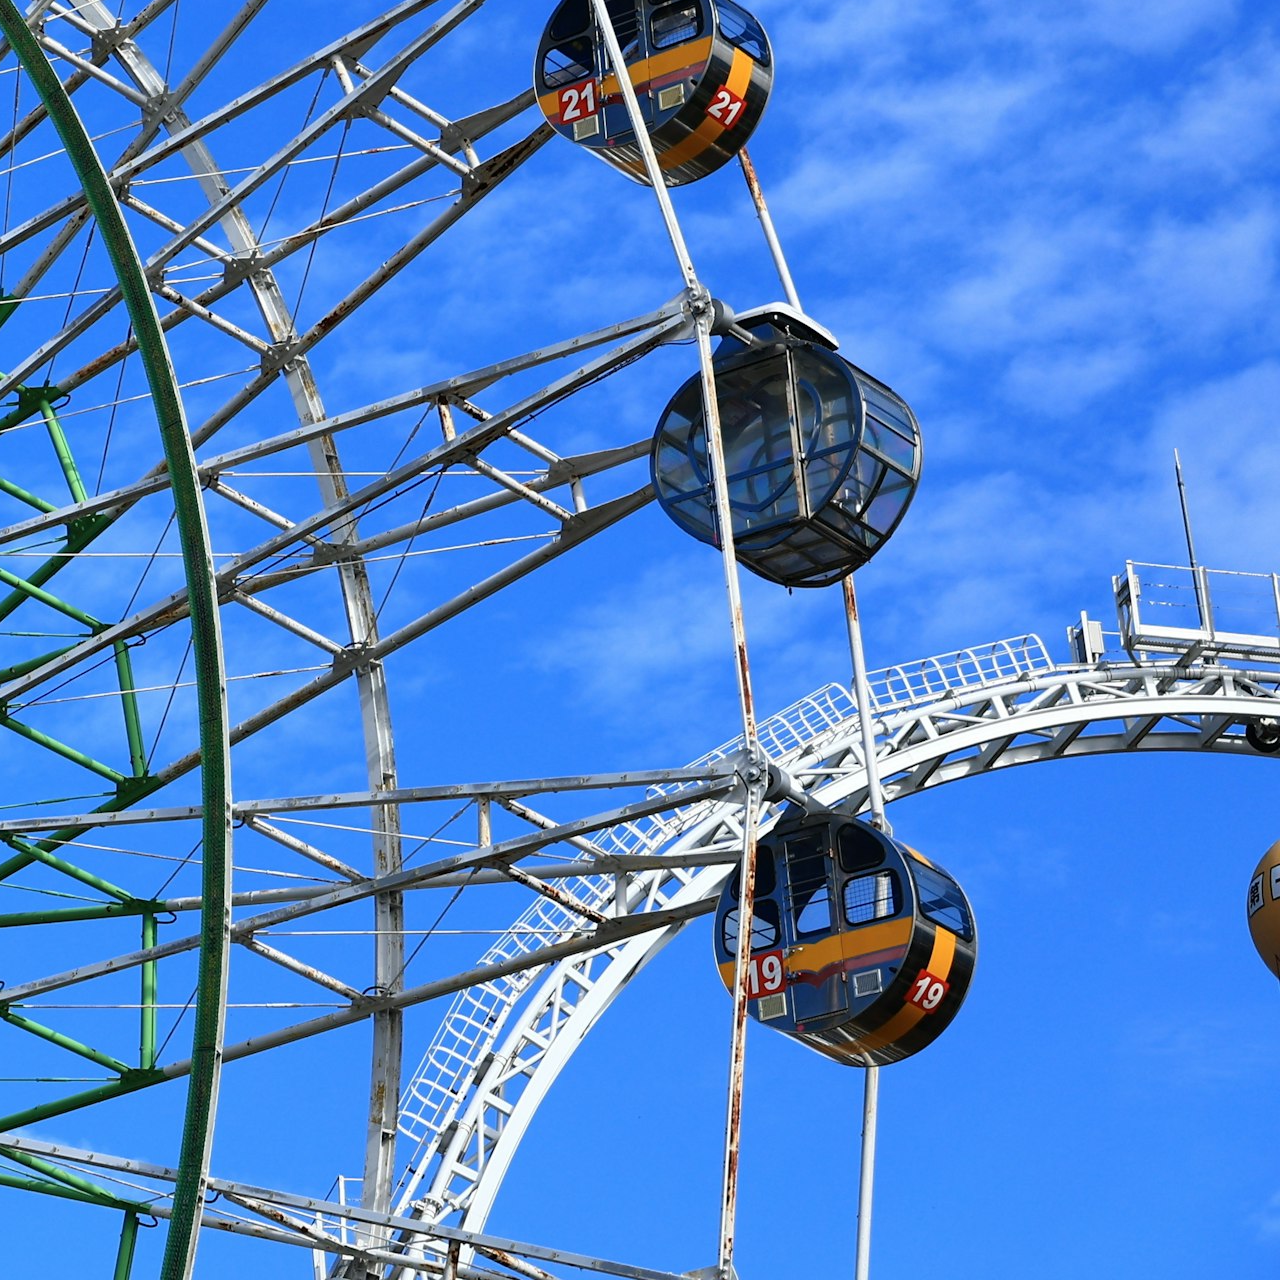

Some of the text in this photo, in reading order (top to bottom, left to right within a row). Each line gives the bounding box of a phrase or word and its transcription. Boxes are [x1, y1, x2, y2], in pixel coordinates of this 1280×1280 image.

[562, 82, 594, 121] 21
[707, 89, 741, 125] 21
[749, 956, 782, 993] 19
[912, 976, 945, 1009] 19
